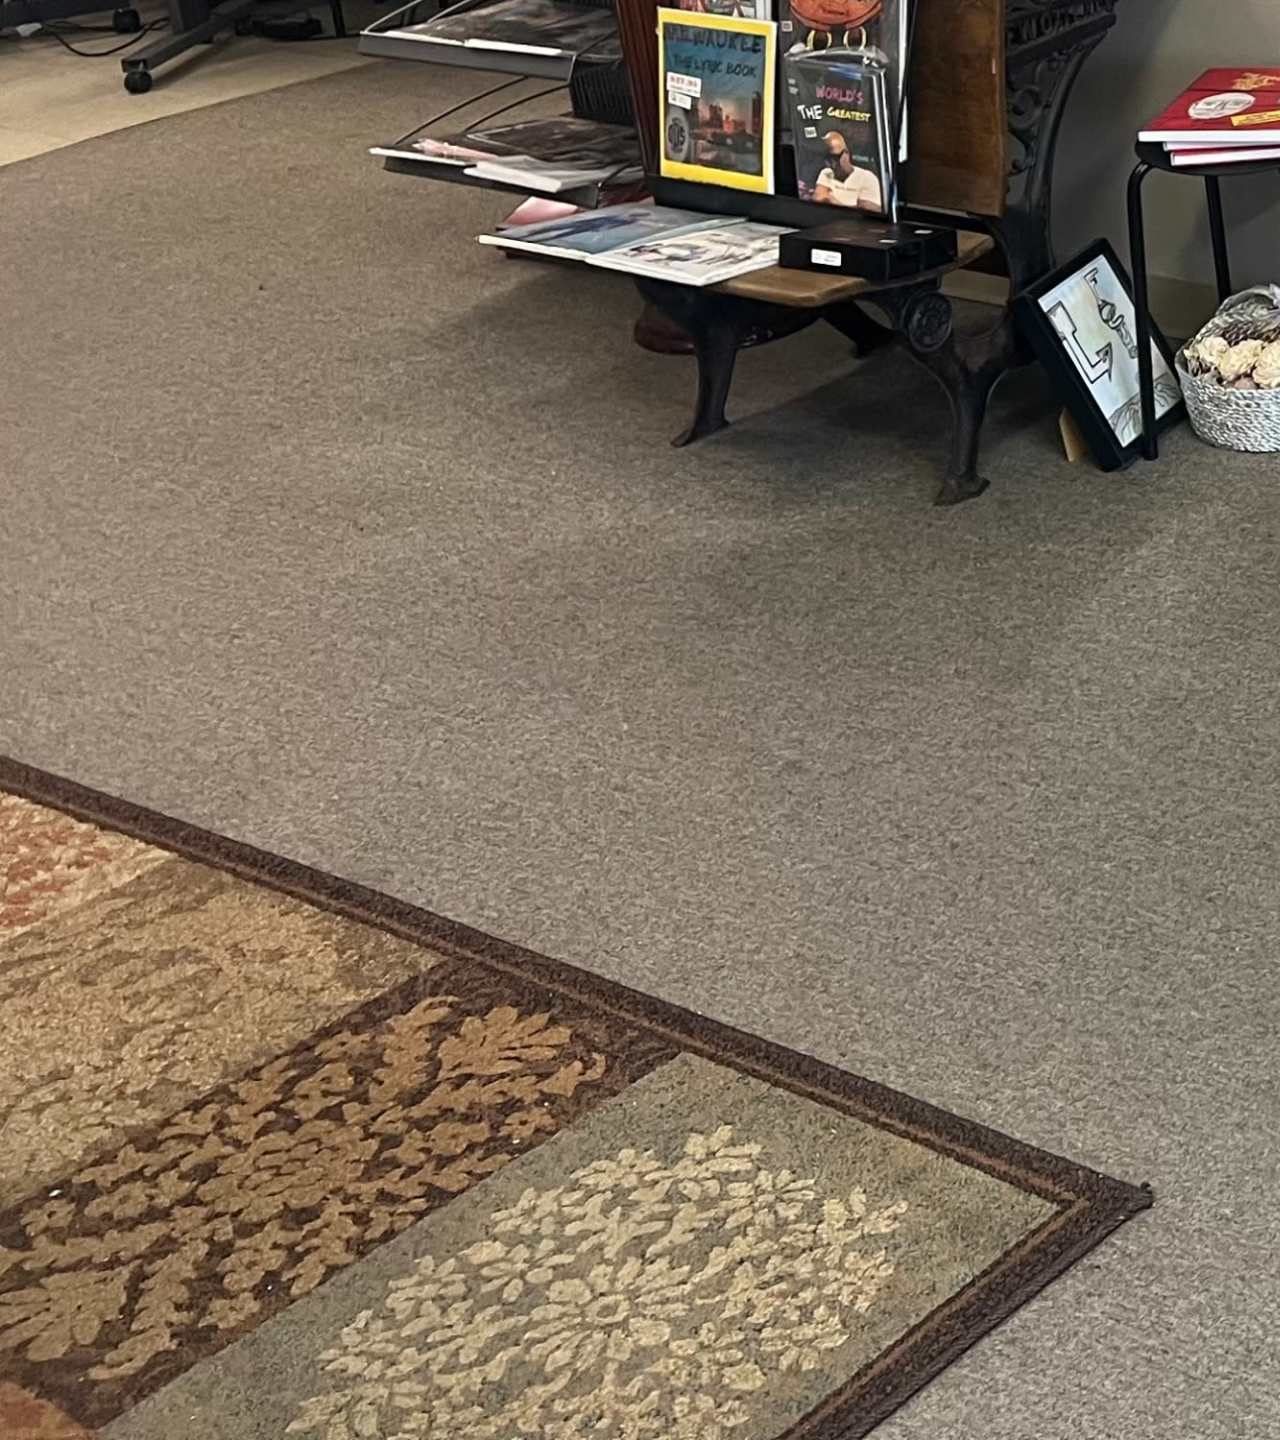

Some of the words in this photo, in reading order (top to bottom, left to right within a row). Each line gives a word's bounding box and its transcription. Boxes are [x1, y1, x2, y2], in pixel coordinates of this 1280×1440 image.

[725, 61, 758, 78] BOOK
[815, 85, 865, 105] WORLD'S
[797, 104, 823, 122] THE
[826, 105, 872, 122] GREATEST
